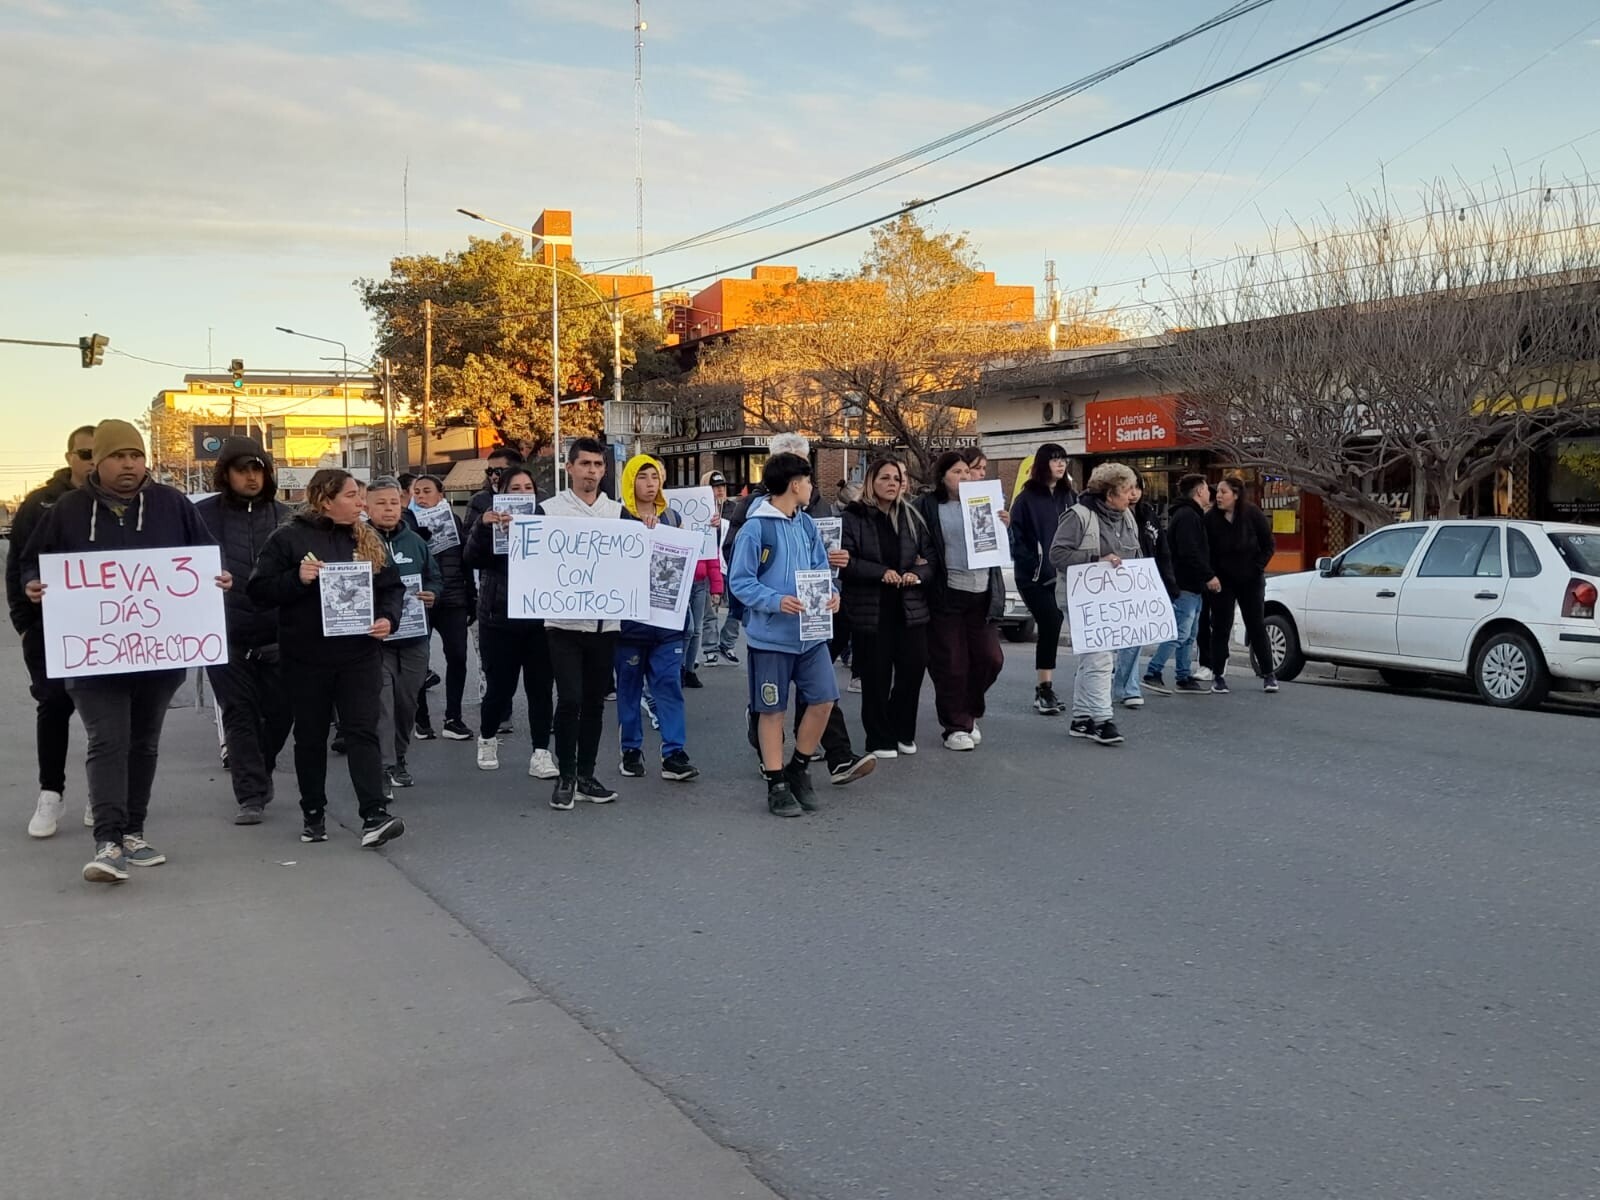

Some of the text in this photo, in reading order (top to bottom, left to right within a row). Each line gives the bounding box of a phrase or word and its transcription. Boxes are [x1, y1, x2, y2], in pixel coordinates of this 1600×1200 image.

[1146, 412, 1158, 424] de
[1116, 425, 1166, 442] Santa Fe
[1367, 492, 1409, 507] TAXI
[547, 528, 645, 563] QUEREMOS
[64, 556, 199, 597] LLEVA 3
[557, 561, 597, 587] CON
[99, 595, 161, 628] DÍAS
[1076, 597, 1166, 627] TE ESTAMOS
[1084, 619, 1175, 648] ESPERANDO!
